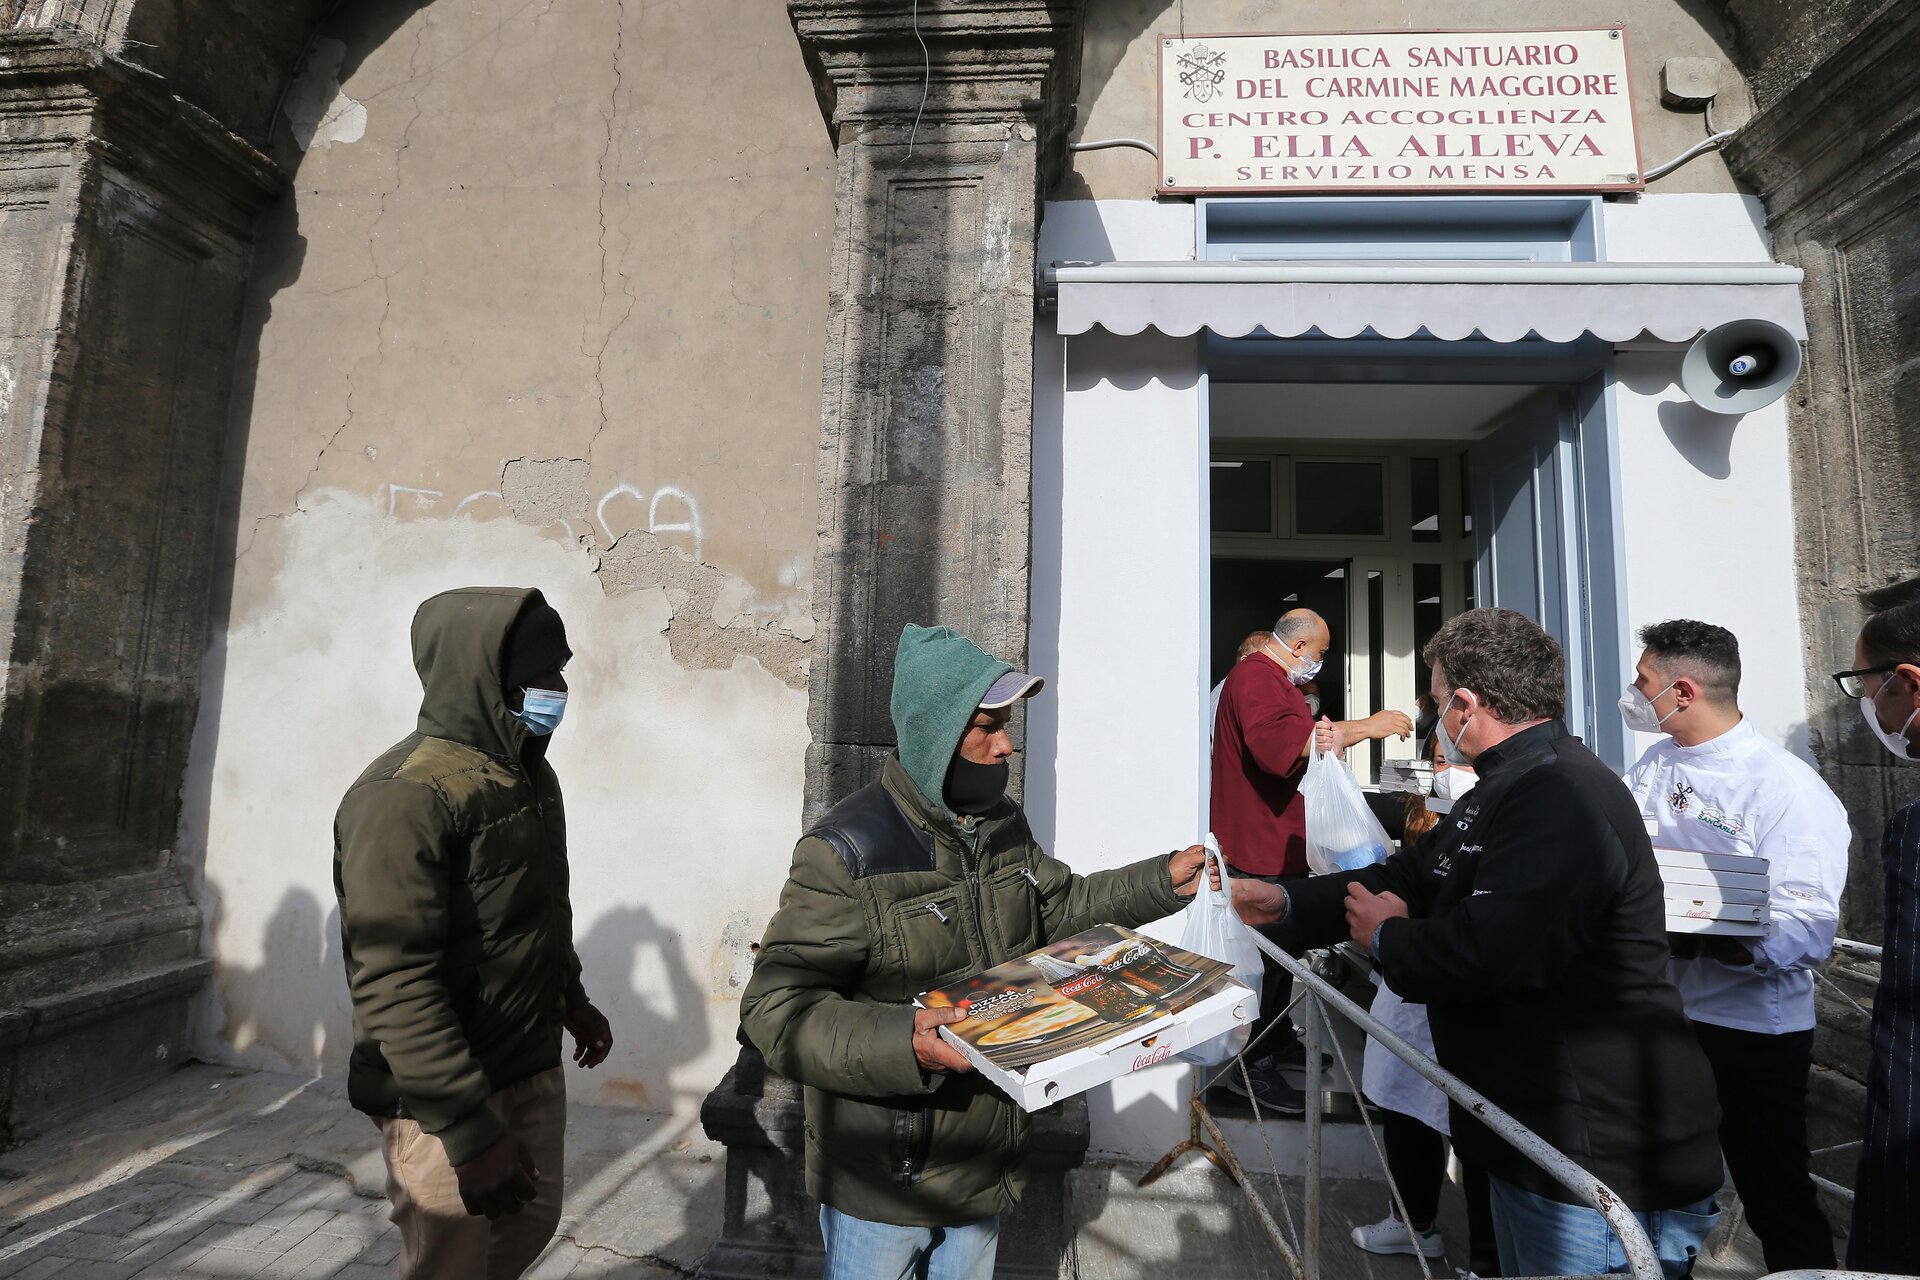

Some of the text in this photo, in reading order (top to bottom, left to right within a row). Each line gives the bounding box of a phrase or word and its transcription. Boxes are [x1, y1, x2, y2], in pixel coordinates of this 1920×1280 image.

[1263, 43, 1579, 69] BASILICA SANTUARIO
[1236, 74, 1618, 99] DEL CARMINE MAGGIORE
[1182, 108, 1607, 128] CENTRO ACCOGLIENZA
[1187, 133, 1606, 160] P. ELIA ALLEVA
[1236, 164, 1557, 181] SERVIZIO MENSA
[1697, 813, 1737, 836] SANCARLO
[968, 987, 1037, 1016] OCA-COLA
